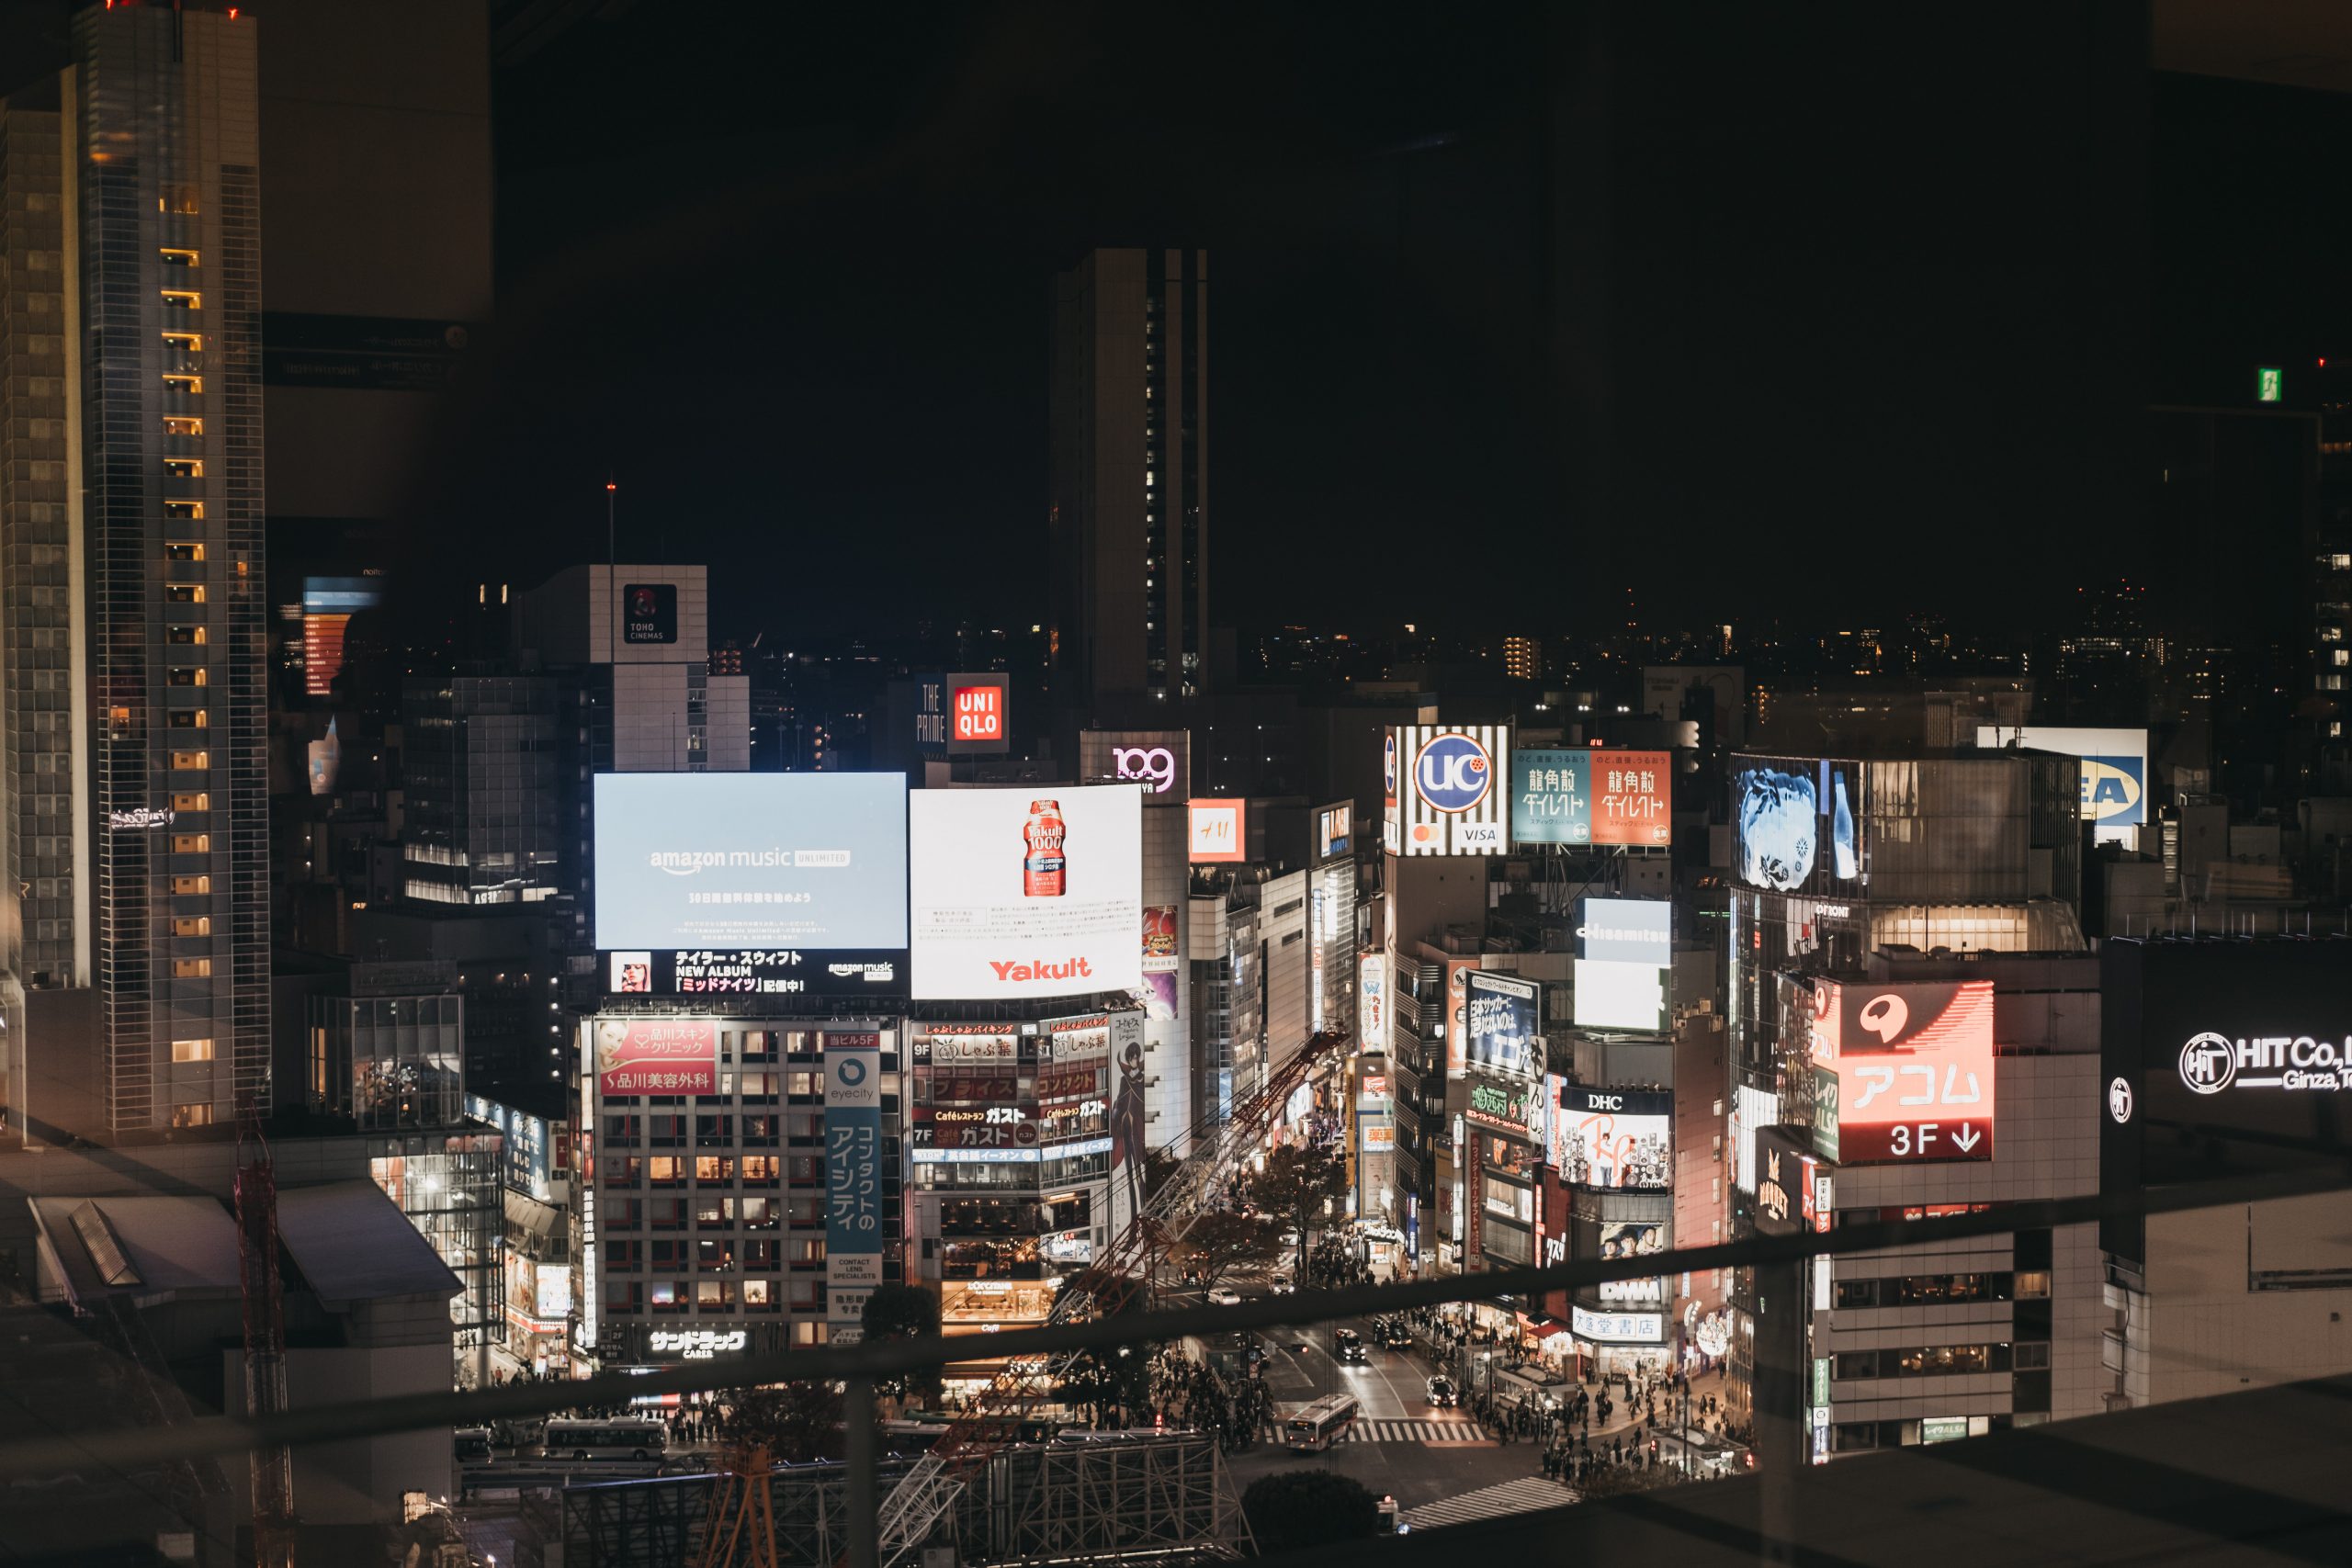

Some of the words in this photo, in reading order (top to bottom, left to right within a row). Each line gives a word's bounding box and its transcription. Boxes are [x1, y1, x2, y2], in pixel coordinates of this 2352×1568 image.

[630, 623, 654, 631] TOHO
[922, 683, 939, 712] THE
[959, 693, 994, 712] UNI
[917, 715, 945, 742] PRIME
[959, 715, 997, 737] QLO
[1518, 755, 1586, 763] のど、直接、うるおう
[1596, 756, 1666, 764] のど、直接、うるおう
[1529, 769, 1575, 792] 龍角散
[1609, 770, 1655, 793] 龍角散
[1522, 794, 1584, 817] ダイレクト
[1601, 795, 1664, 818] ダイレクト
[1028, 825, 1063, 837] Yakult
[1330, 807, 1350, 839] LABI
[1027, 836, 1062, 850] 1000
[1464, 829, 1496, 840] VISA
[650, 851, 726, 872] amazon
[729, 847, 791, 866] music
[798, 853, 846, 863] UNLIMITED
[675, 951, 802, 965] テイラー・スウィフト
[675, 966, 706, 977] NEW
[708, 966, 752, 977] ALBUM
[829, 963, 863, 976] amazon
[864, 962, 893, 972] music
[989, 956, 1092, 981] Yakult
[1470, 995, 1512, 1018] 日本サッカーに
[650, 1028, 709, 1040] 品川スキン
[925, 1024, 1013, 1034] しゃぶしゃぶバイキング
[1470, 1011, 1517, 1039] 足りないのは、
[650, 1041, 704, 1055] クリニック
[830, 1035, 874, 1045] 当ビル5F
[914, 1044, 930, 1055] 9F
[961, 1041, 1012, 1056] しゃぶ葉
[1071, 1032, 1105, 1052] しゃぶ葉
[1809, 1030, 1834, 1059] アコム
[617, 1073, 709, 1089] 品川美容外科
[1038, 1073, 1093, 1093] コンタクト
[1853, 1064, 1981, 1110] アコム
[2283, 1070, 2340, 1091] Ginza,
[831, 1088, 874, 1100] eyecity
[1588, 1094, 1623, 1111] DHC
[1815, 1077, 1838, 1110] レイク
[986, 1108, 1025, 1123] ガスト
[1080, 1100, 1106, 1117] ガスト
[1814, 1107, 1838, 1138] ALSA
[914, 1129, 933, 1141] 7F
[961, 1126, 1010, 1145] ガスト
[1890, 1123, 1939, 1156] 3F
[948, 1150, 1019, 1161] 英会話イーオン
[1063, 1138, 1111, 1157] 英会話イーオン
[831, 1126, 854, 1230] アイシティ
[858, 1126, 875, 1230] コンタクトの
[1471, 1147, 1479, 1224] ウィンターフルーツギフト
[835, 1294, 869, 1303] 隐形眼
[1600, 1280, 1660, 1301] DMM
[1575, 1312, 1655, 1335] 大盛堂書店
[650, 1331, 747, 1350] サンドラッグ
